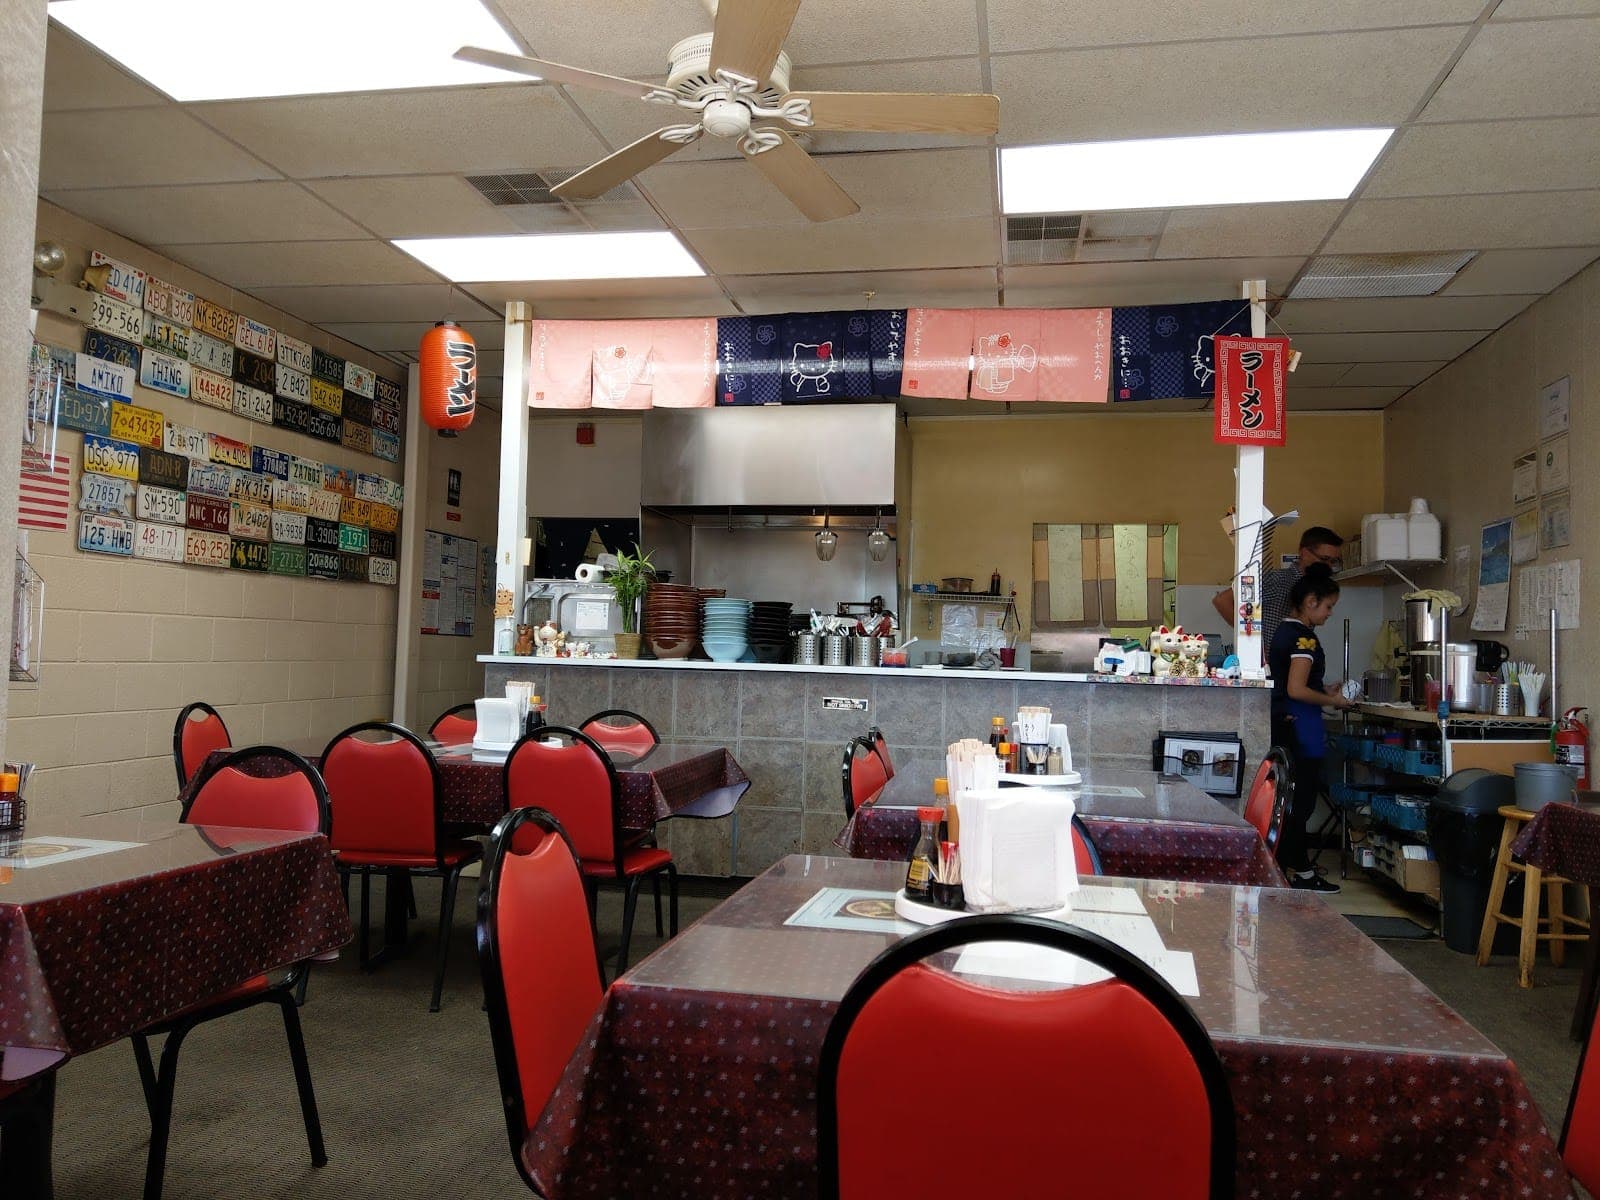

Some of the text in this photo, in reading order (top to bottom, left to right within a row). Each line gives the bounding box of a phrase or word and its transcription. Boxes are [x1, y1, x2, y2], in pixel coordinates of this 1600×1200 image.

[123, 274, 143, 296] 414
[147, 289, 166, 313] ABC
[173, 299, 192, 322] 306
[196, 304, 235, 335] NK-6262
[239, 327, 254, 347] GEL
[91, 367, 123, 394] AMIKO
[151, 361, 182, 386] THING
[446, 340, 476, 417] ラーメン
[1239, 350, 1264, 430] ラーメン
[128, 415, 161, 438] 43432
[117, 451, 137, 473] 977
[88, 482, 121, 504] 27857
[252, 479, 270, 499] 315
[144, 492, 180, 515] SM-590
[96, 517, 123, 528] Washington
[212, 508, 229, 525] 166
